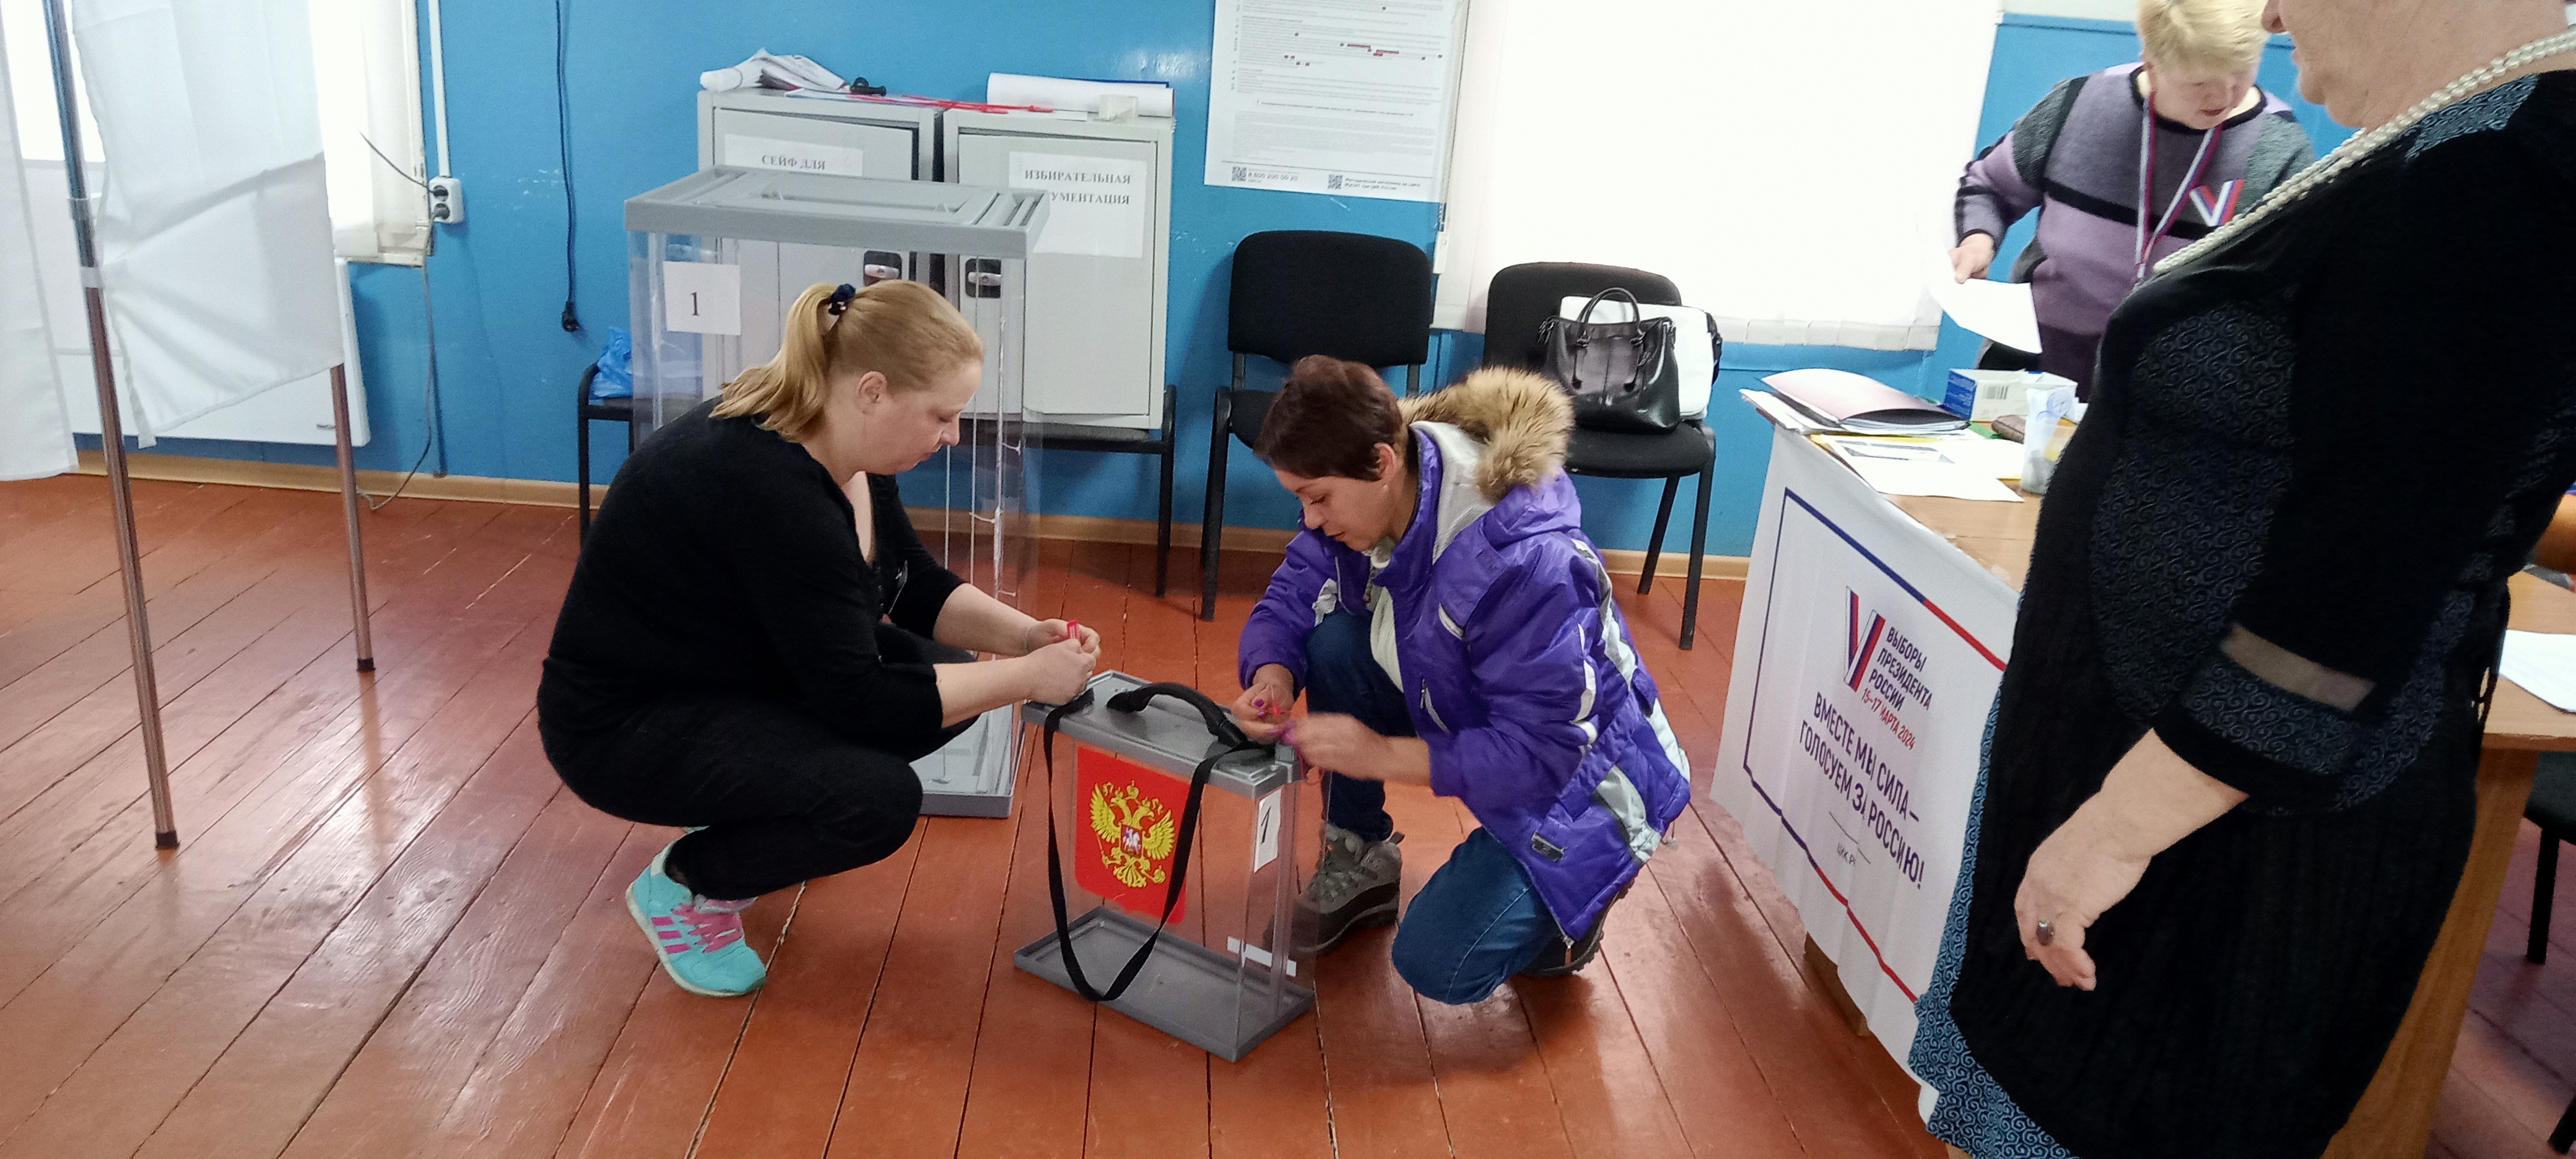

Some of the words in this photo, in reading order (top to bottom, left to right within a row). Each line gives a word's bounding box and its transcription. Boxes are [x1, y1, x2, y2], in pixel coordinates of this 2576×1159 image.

[762, 154, 797, 167] СЕЙФ
[800, 159, 826, 170] ДЛЯ
[1024, 169, 1131, 184] ИЗБИРАТЕЛЬНАЯ
[1051, 191, 1129, 205] УМЕНТАЦИЯ
[690, 291, 700, 316] 1
[1886, 627, 1927, 673] ВЫБОРЫ
[1868, 669, 1905, 711] РОССИИ
[1877, 648, 1932, 711] ПРЕЗИДЕНТА
[1814, 692, 1855, 756] ВМЕСТЕ
[1854, 737, 1877, 781] МЫ
[1897, 725, 1915, 750] 2024
[1260, 805, 1271, 845] 1
[1799, 720, 1853, 801] ГОЛОСУЕМ
[1868, 800, 1925, 890] РОССИЮ!
